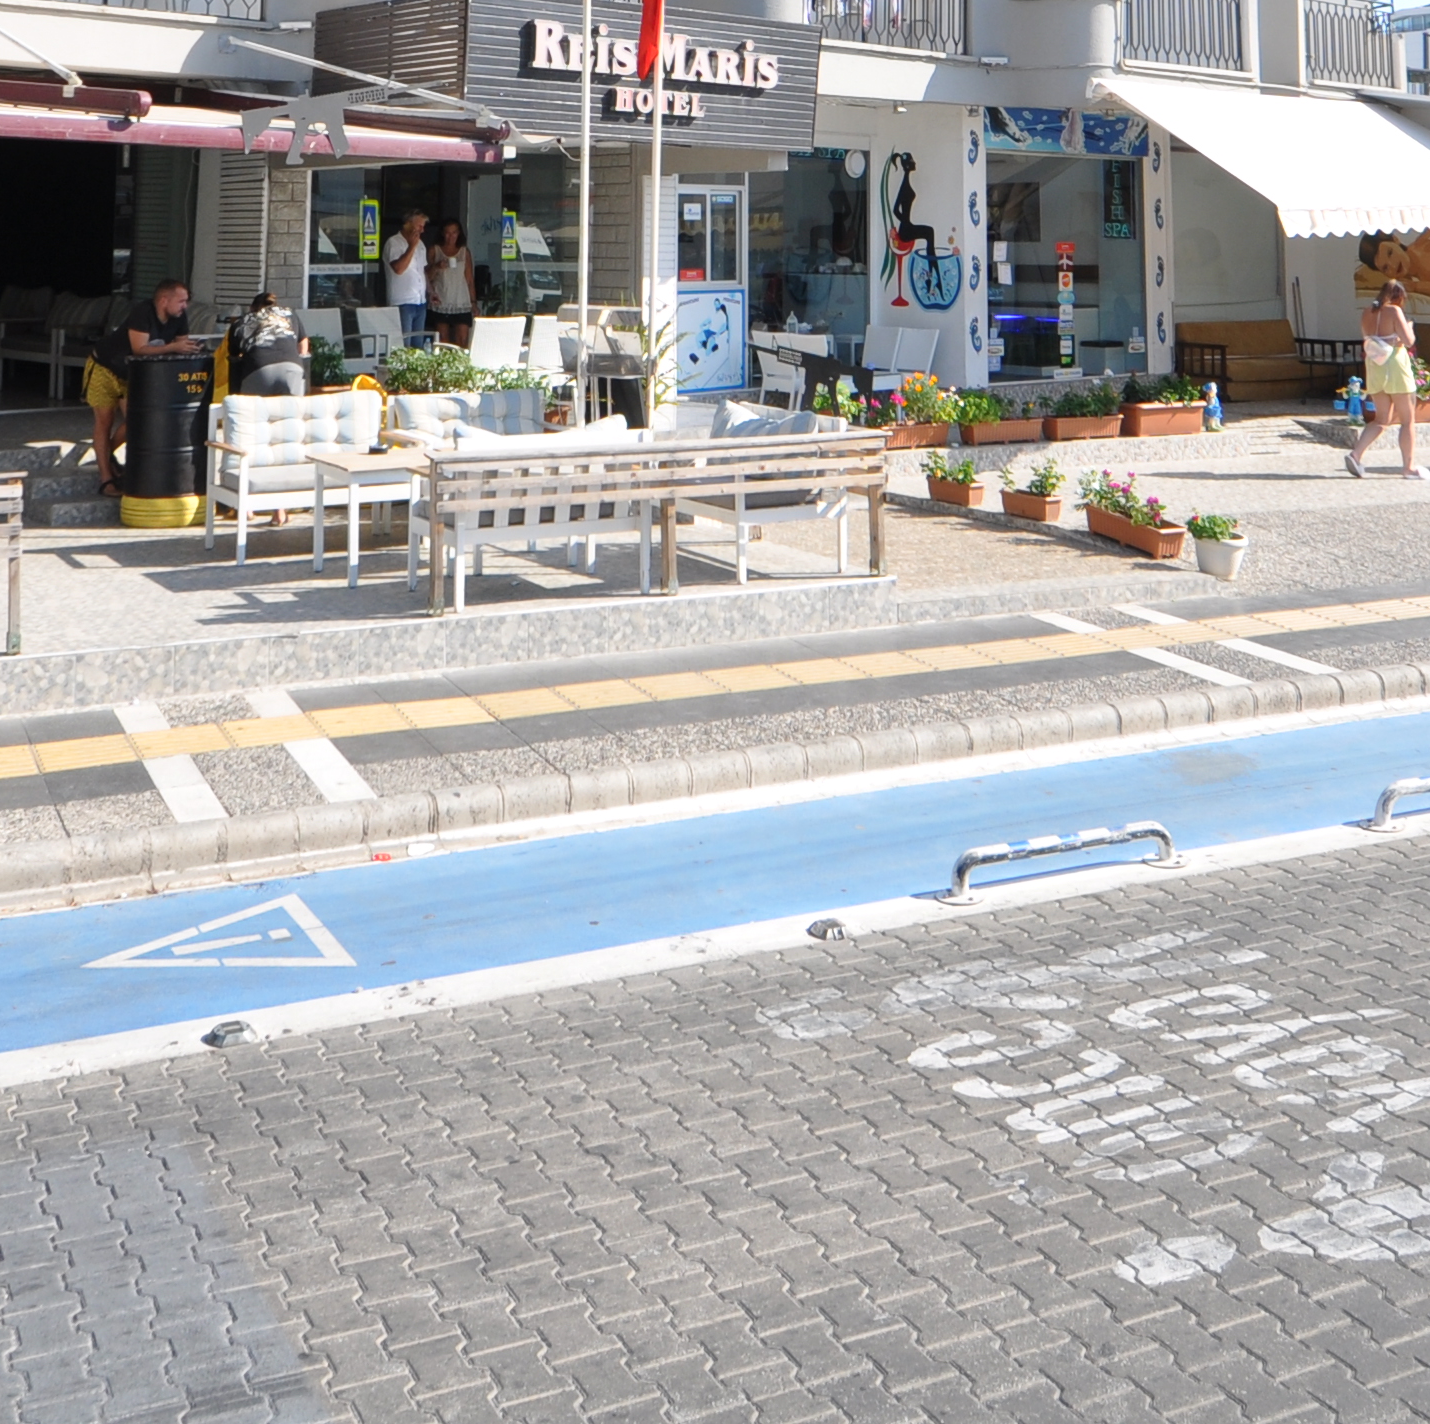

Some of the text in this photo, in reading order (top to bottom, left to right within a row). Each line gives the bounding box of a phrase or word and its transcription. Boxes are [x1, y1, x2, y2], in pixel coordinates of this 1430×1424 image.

[614, 87, 707, 118] HOTEL
[1110, 160, 1125, 220] FISH
[1104, 222, 1131, 237] SPA
[178, 372, 189, 382] 30
